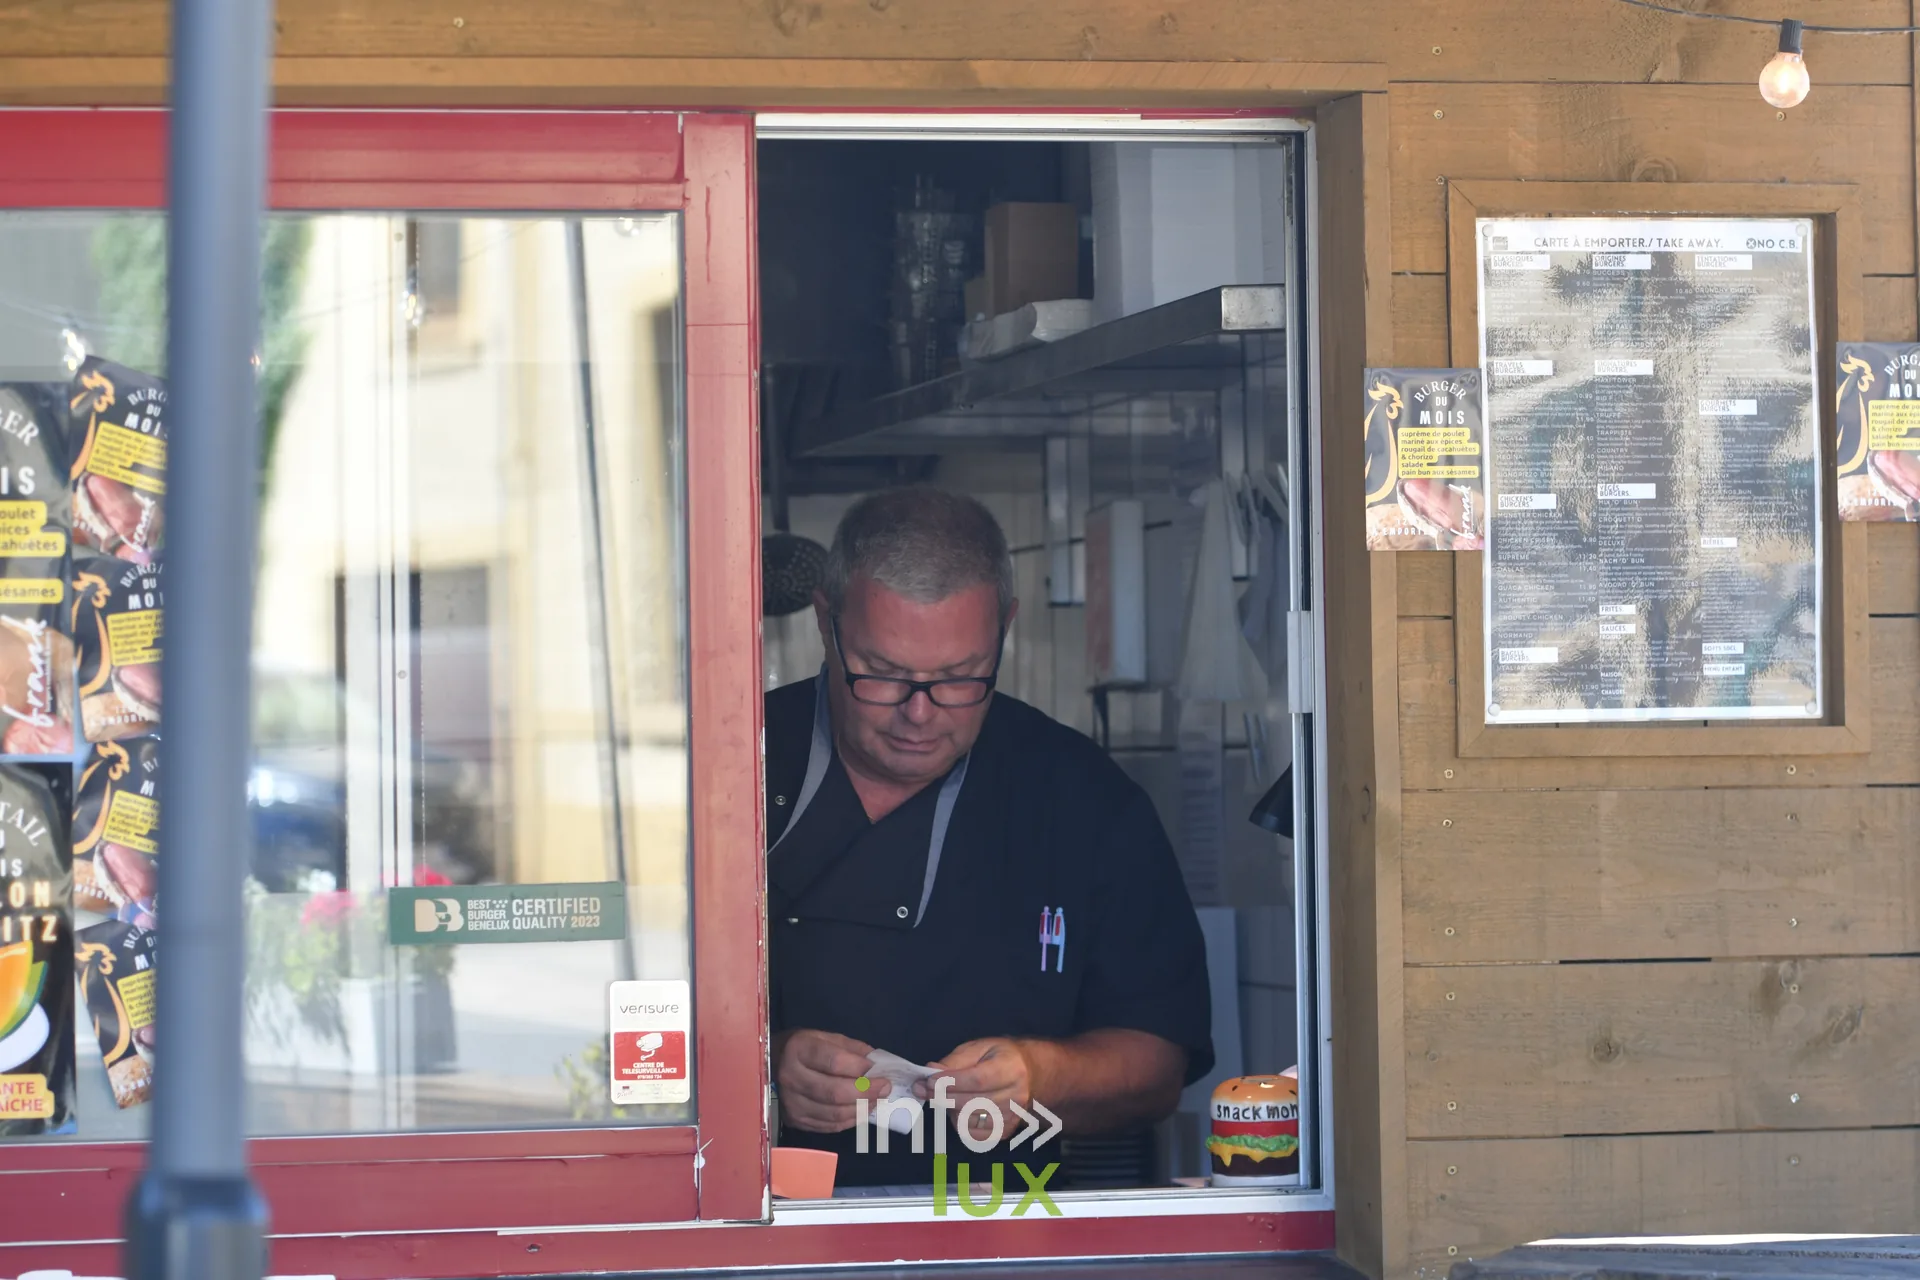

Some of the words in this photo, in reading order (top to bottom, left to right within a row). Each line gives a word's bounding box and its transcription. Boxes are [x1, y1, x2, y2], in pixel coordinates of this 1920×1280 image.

[1534, 237, 1569, 248] CARTE
[1573, 235, 1581, 248] À
[1656, 237, 1684, 248] TAKE
[1687, 237, 1724, 249] AWAY.
[1757, 239, 1775, 249] NO
[1778, 239, 1799, 250] C.B.
[1904, 369, 1917, 380] DU
[1414, 380, 1467, 403] BURGER
[1435, 396, 1448, 406] DU
[146, 403, 162, 417] DU
[1419, 410, 1465, 425] MOIS
[1401, 430, 1431, 438] suprême
[1442, 430, 1465, 438] poulet
[1440, 438, 1463, 446] épices
[142, 578, 157, 590] DU
[467, 899, 491, 910] BEST
[512, 897, 601, 916] CERTIFIED
[467, 910, 507, 920] BURGER
[3, 914, 58, 942] ITZ
[467, 920, 510, 931] BENELUX
[512, 916, 566, 930] QUALITY
[570, 915, 601, 928] 2023
[619, 1004, 679, 1014] verisure
[1216, 1104, 1261, 1121] snack
